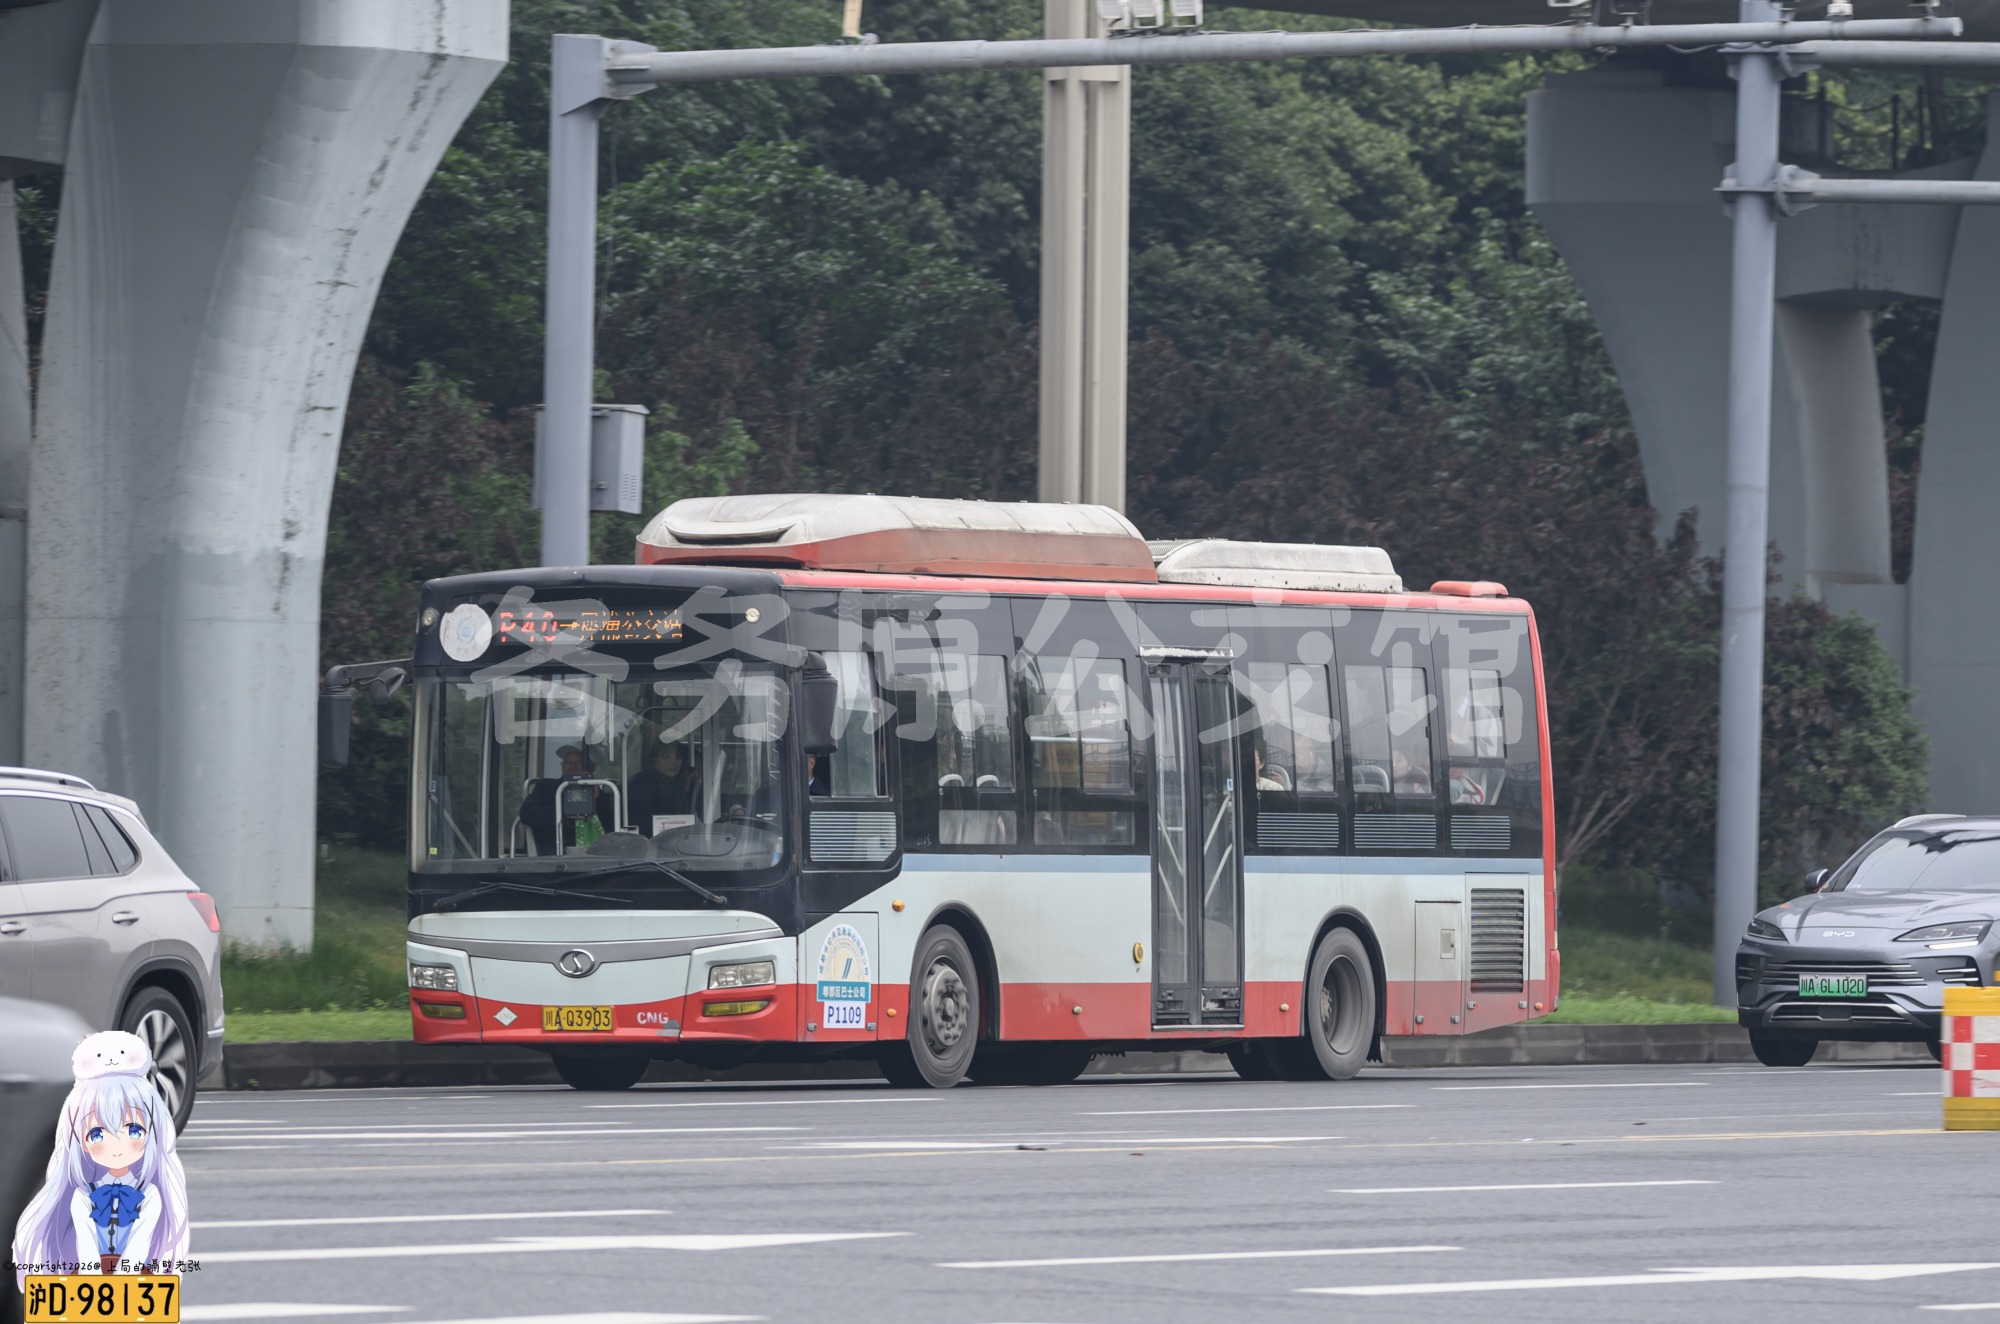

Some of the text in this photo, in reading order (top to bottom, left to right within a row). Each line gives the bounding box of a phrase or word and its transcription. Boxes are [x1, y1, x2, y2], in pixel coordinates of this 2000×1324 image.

[1822, 930, 1856, 938] BYD
[636, 1011, 669, 1025] CNG
[827, 1005, 862, 1025] P1109
